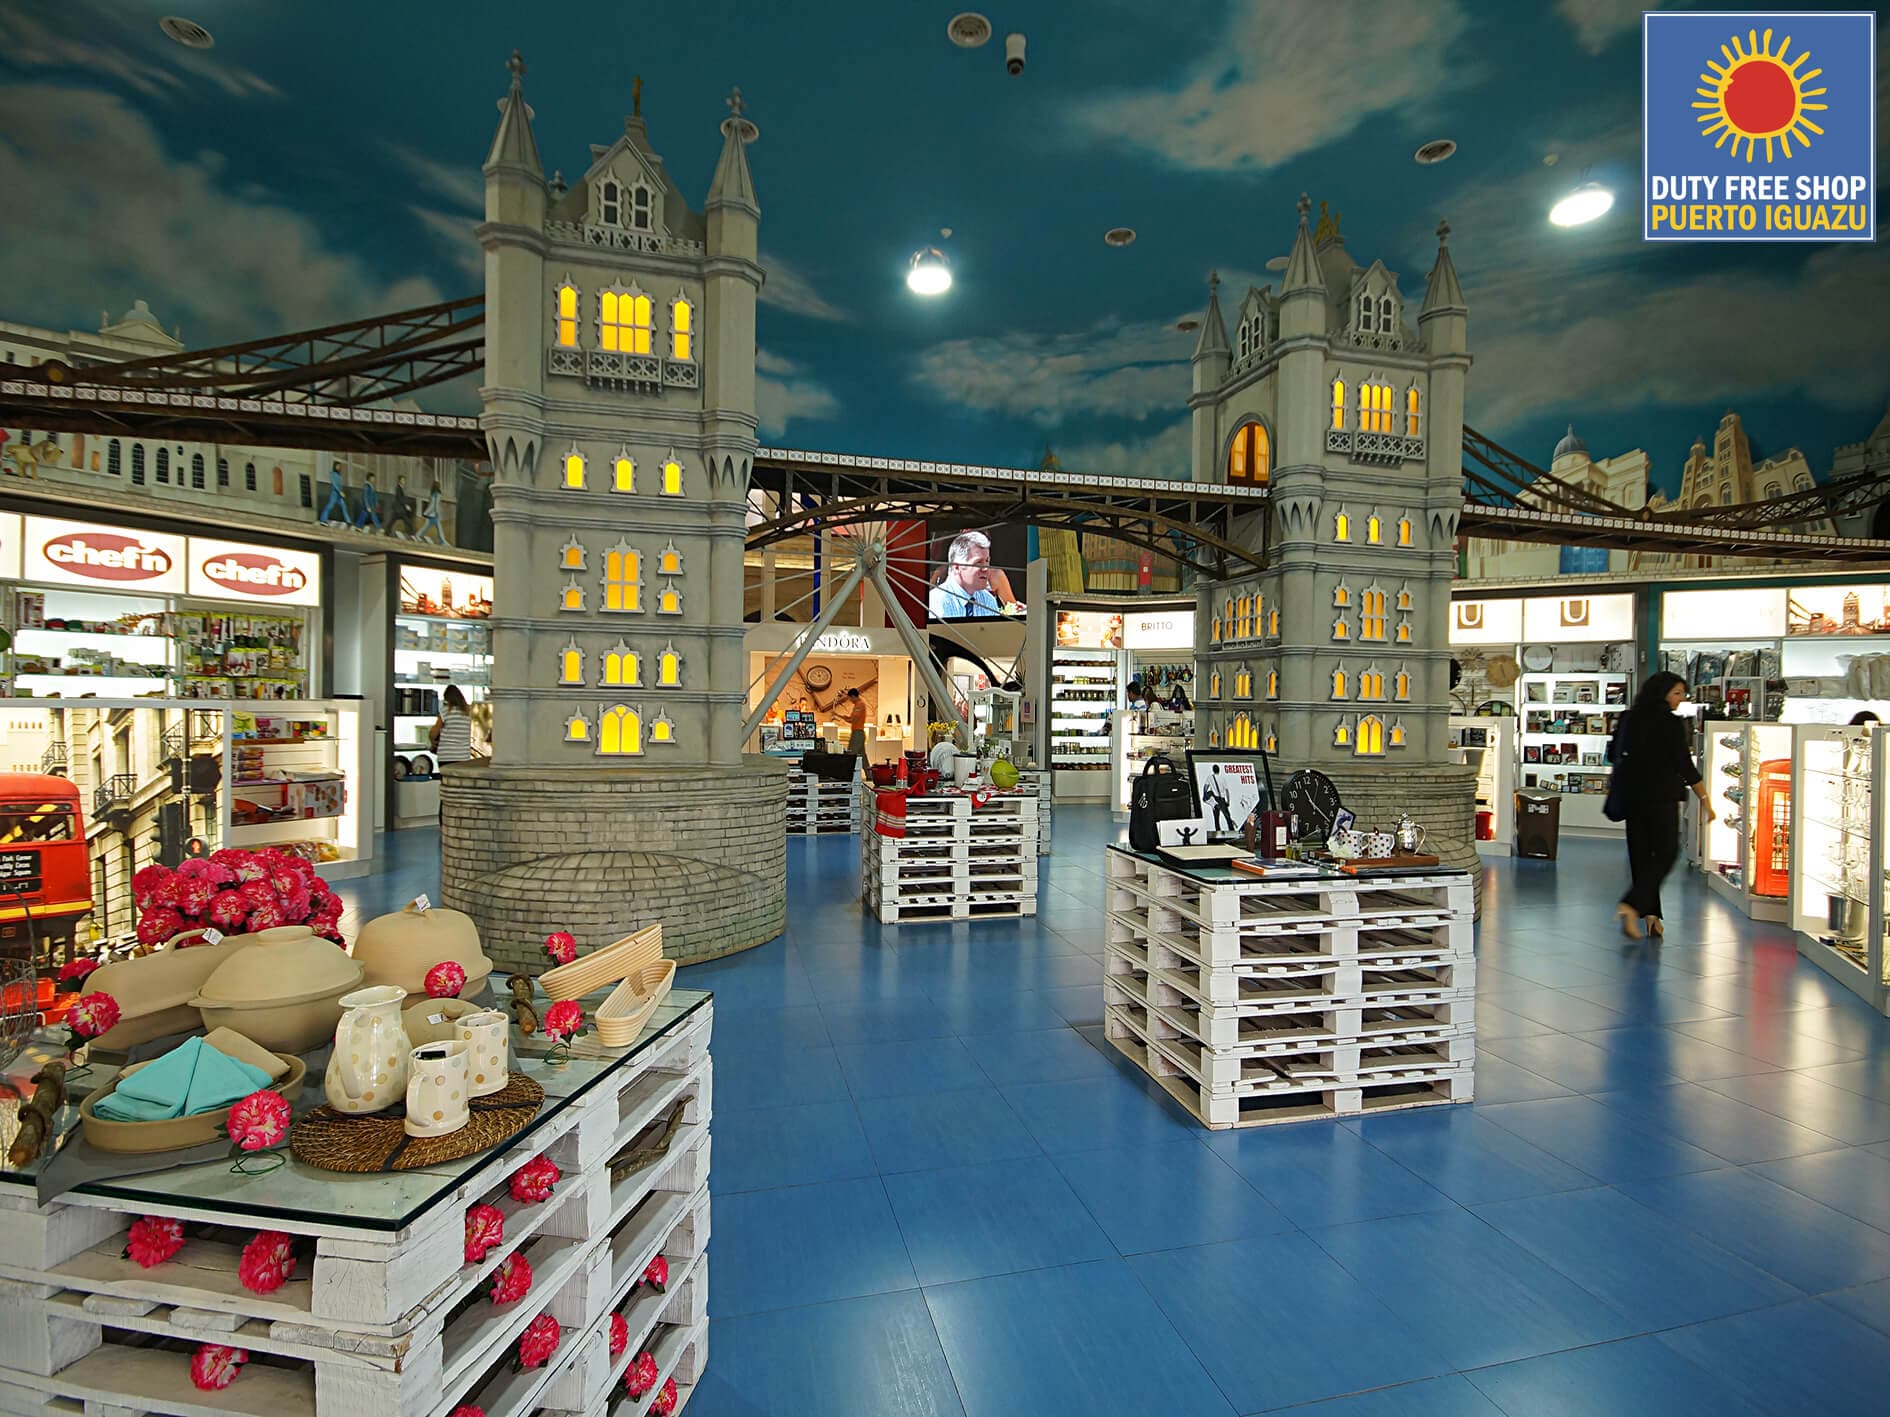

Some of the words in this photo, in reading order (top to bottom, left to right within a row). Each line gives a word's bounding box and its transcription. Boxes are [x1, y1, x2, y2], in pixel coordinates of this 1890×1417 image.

[46, 538, 168, 573] chef'n
[204, 557, 304, 589] chef'n
[1141, 621, 1173, 632] BRITTO
[1224, 764, 1253, 774] GREATEST
[1240, 775, 1255, 785] HITS
[1303, 776, 1311, 785] 12
[1294, 781, 1302, 790] 11
[1323, 785, 1329, 794] 2
[1290, 790, 1298, 799] 10
[1330, 797, 1336, 807] 3
[1290, 803, 1295, 812] 9
[1305, 822, 1310, 832] 7
